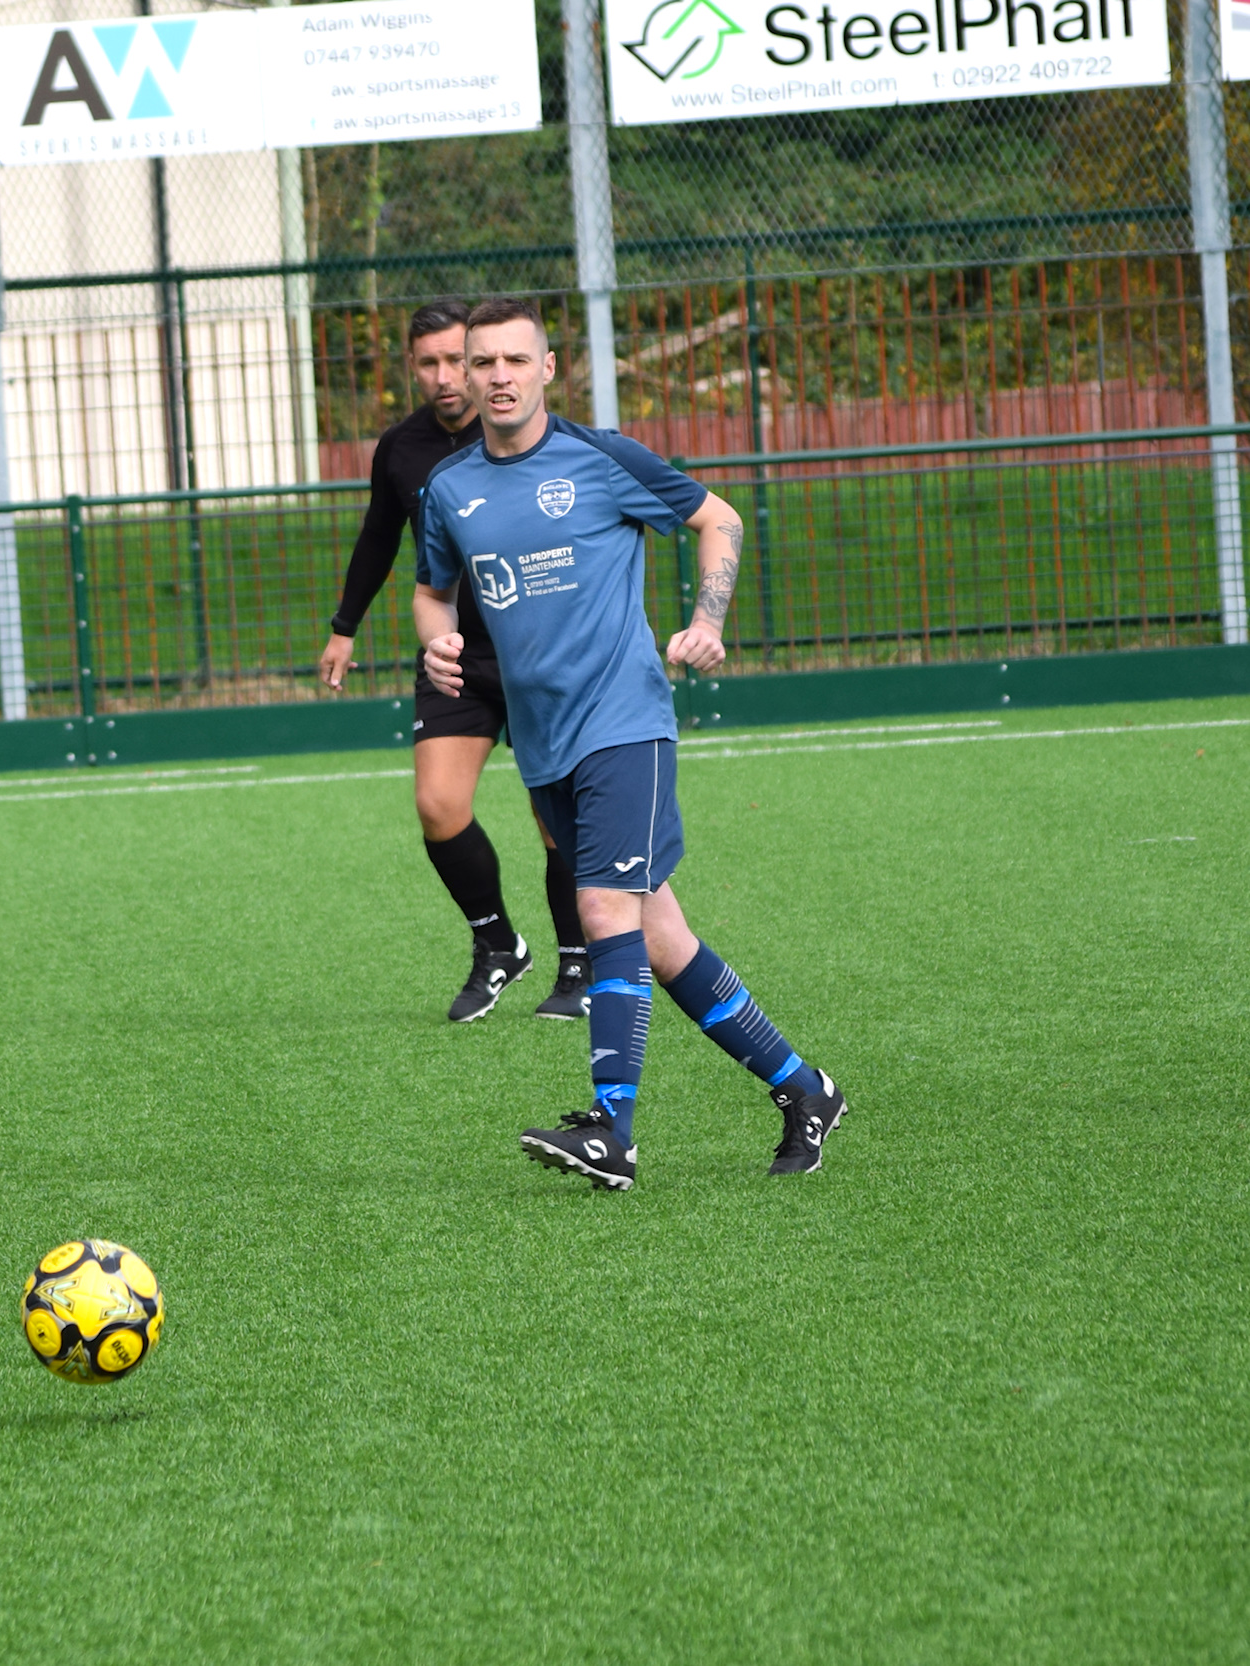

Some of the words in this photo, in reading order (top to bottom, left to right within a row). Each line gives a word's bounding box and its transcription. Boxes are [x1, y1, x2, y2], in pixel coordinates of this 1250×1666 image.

[302, 17, 354, 33] Adam
[360, 12, 433, 31] Wiggins
[303, 46, 362, 66] 07447
[368, 40, 441, 61] 939470
[952, 63, 1022, 87] 02922
[1029, 56, 1113, 81] 409722
[670, 76, 898, 108] www.SteelPhalt.com
[518, 555, 530, 565] GJ
[530, 547, 573, 562] PROPERTY
[521, 556, 576, 574] MAINTENANCE
